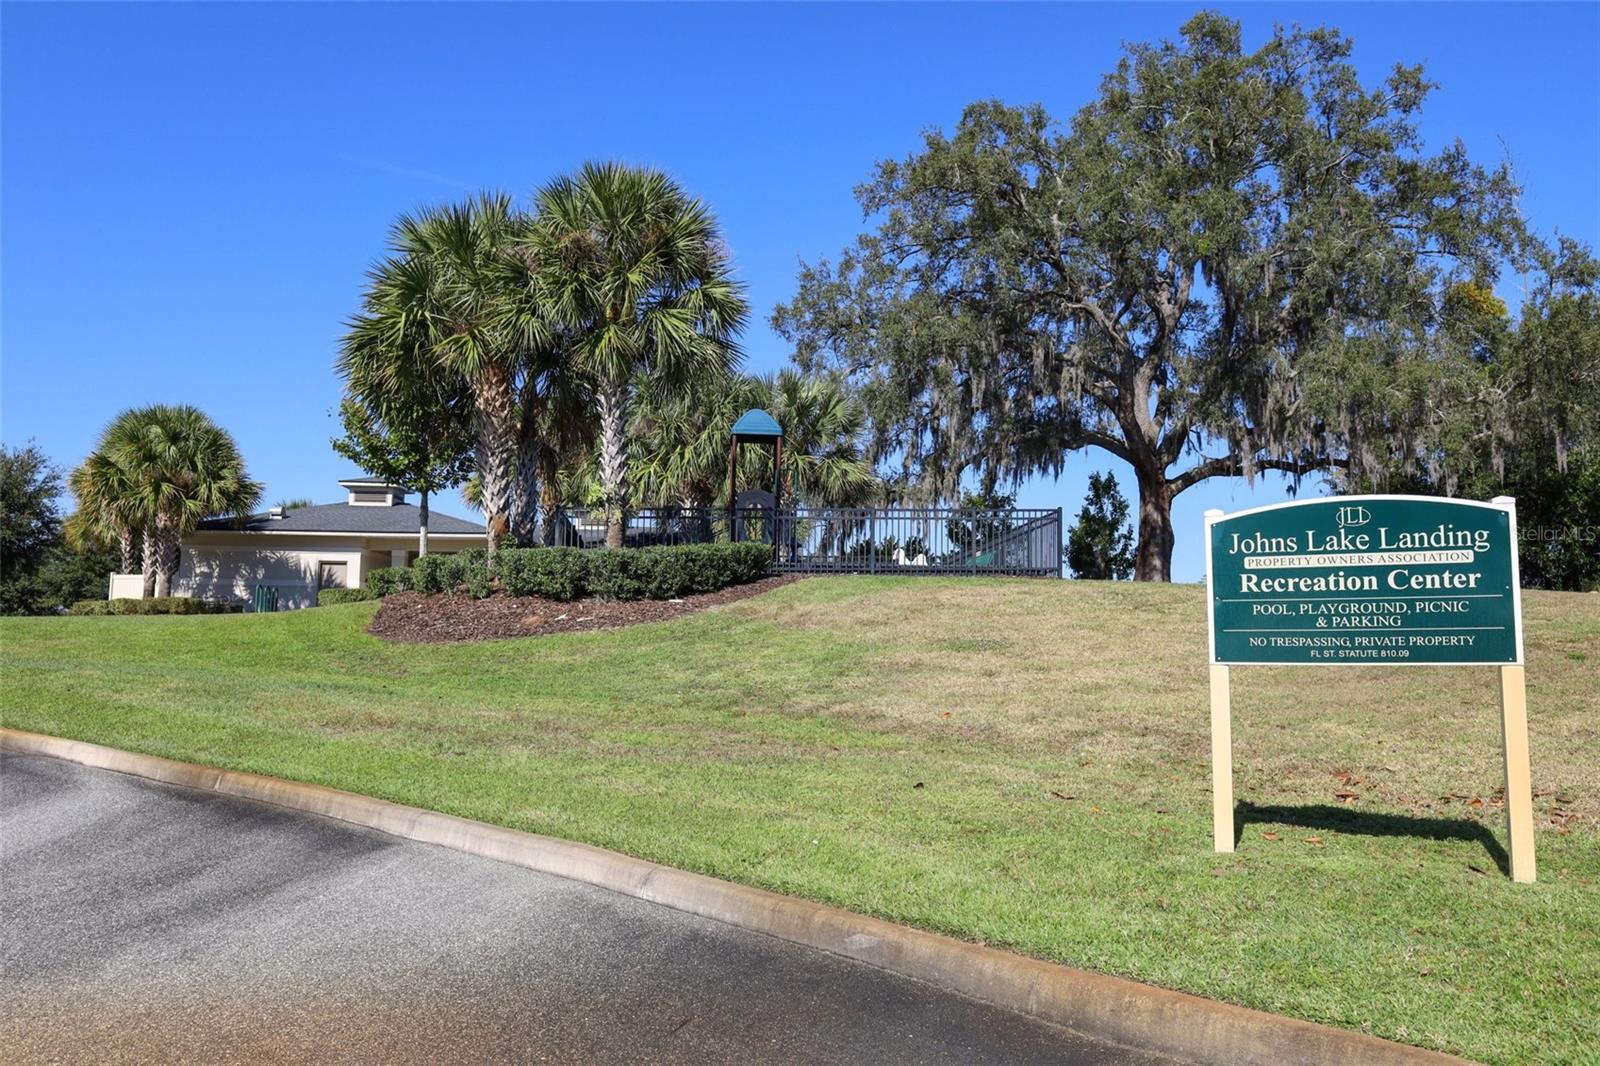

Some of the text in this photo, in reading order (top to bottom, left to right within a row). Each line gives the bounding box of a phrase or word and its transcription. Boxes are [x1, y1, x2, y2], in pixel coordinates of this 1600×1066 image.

[1229, 525, 1490, 555] Johns Lake Landing
[1247, 551, 1471, 568] PROPERTY OWNERS ASSOCIATION
[1239, 568, 1482, 593] Recreation Center
[1252, 600, 1470, 616] POOL, PLAYGROUND, PICNIC
[1316, 615, 1402, 628] & PARKING
[1249, 636, 1476, 648] NO TRESPASSING, PRIVATE PROPERTY
[1310, 649, 1410, 658] FL ST. STATUTE 810.09
